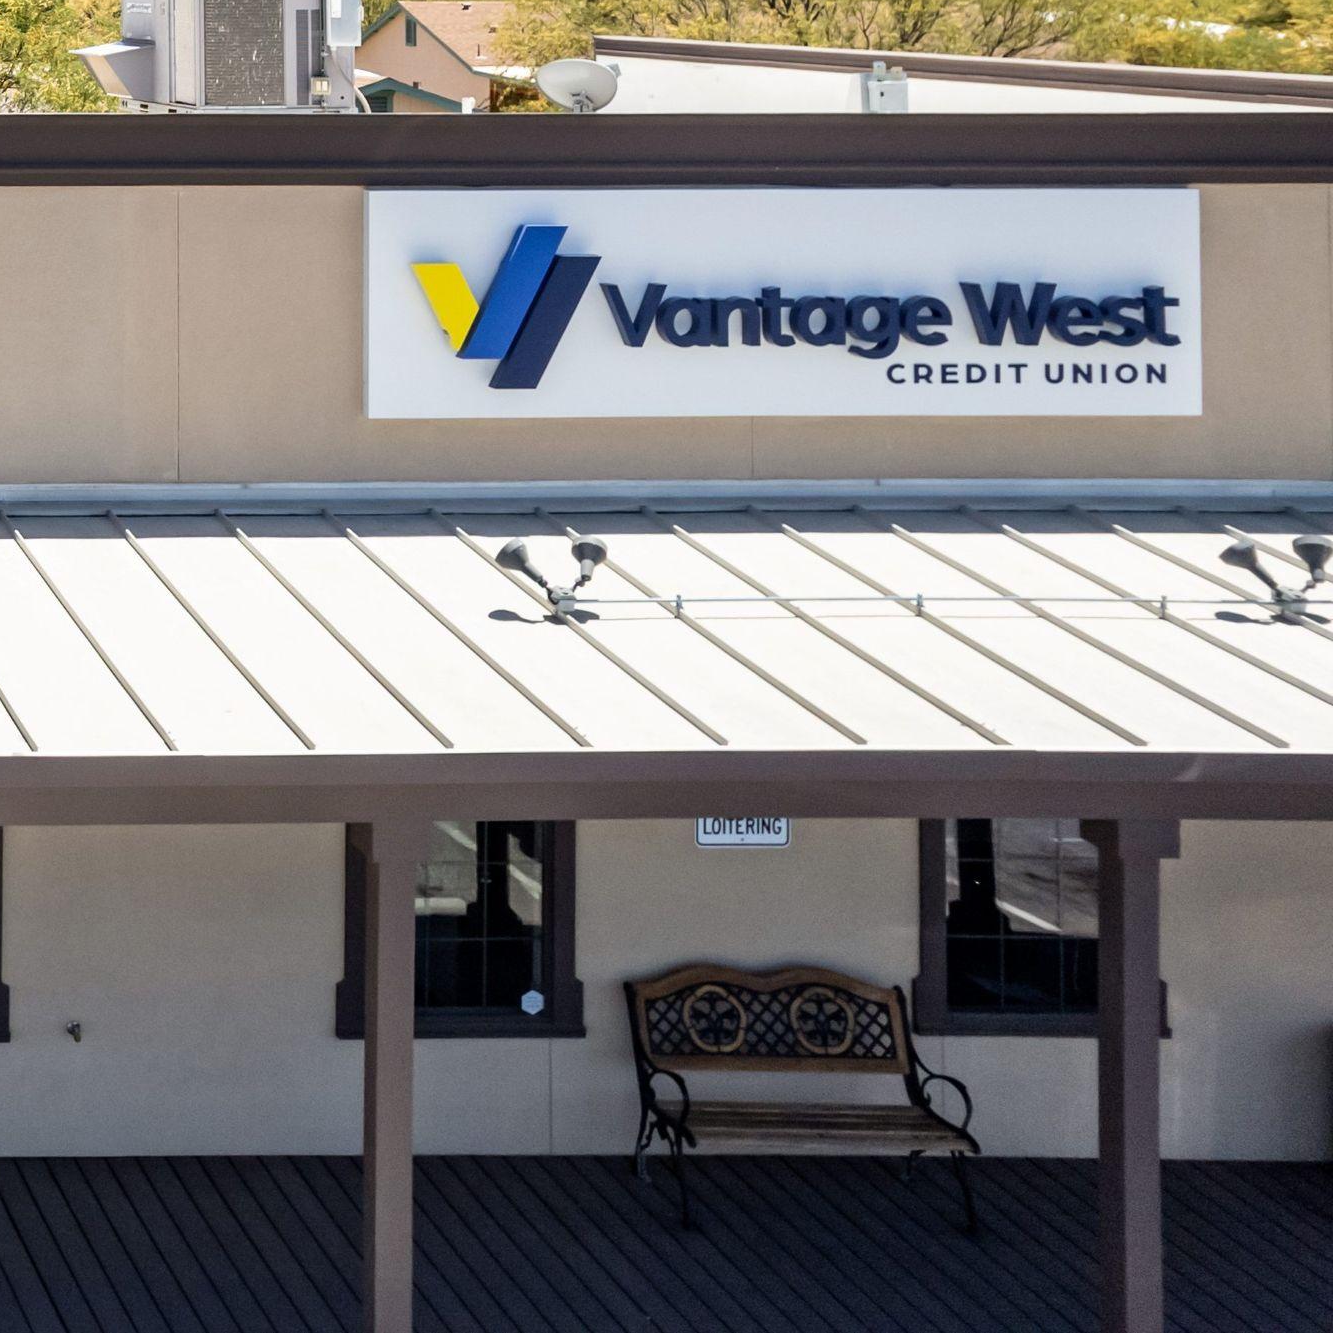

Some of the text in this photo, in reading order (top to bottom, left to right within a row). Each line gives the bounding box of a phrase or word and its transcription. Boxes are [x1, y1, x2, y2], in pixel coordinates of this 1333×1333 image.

[599, 281, 1181, 359] Vantage West
[886, 363, 1167, 384] CREDIT UNION
